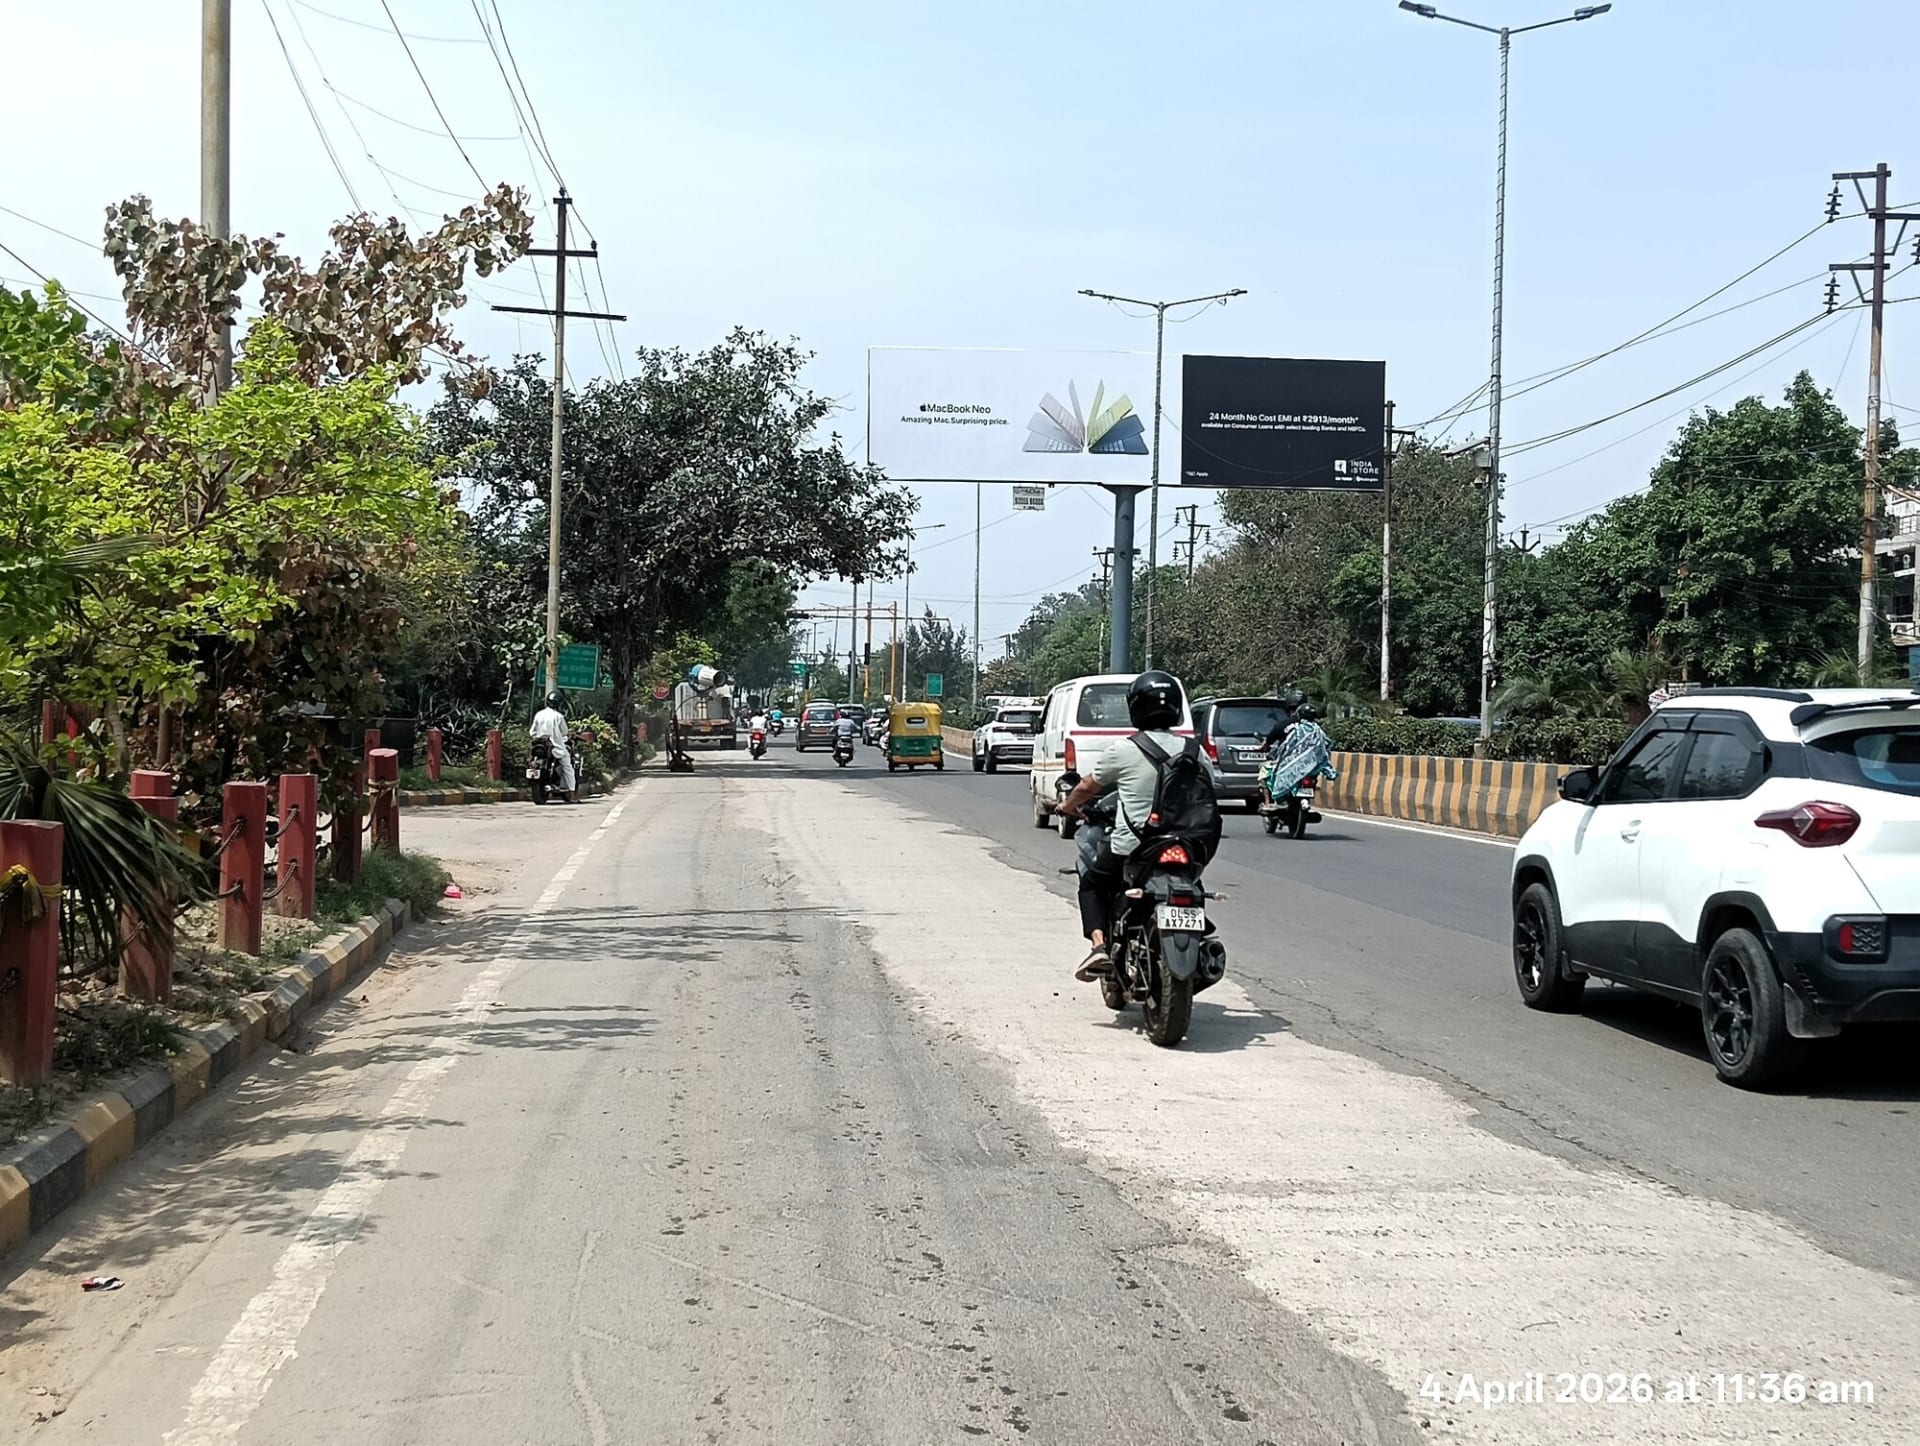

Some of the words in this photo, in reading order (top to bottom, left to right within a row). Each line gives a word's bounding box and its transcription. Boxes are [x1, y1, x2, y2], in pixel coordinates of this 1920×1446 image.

[927, 403, 971, 413] MacBook
[971, 405, 991, 414] Neo
[900, 416, 932, 425] Amazing
[950, 417, 988, 426] Surprising
[988, 418, 1010, 426] price.
[1209, 412, 1220, 421] 24
[1220, 412, 1245, 421] Month
[1246, 413, 1258, 422] No
[1258, 413, 1276, 422] Cost
[1278, 414, 1292, 423] EMI
[1293, 415, 1301, 423] at
[1170, 908, 1198, 919] DL5S
